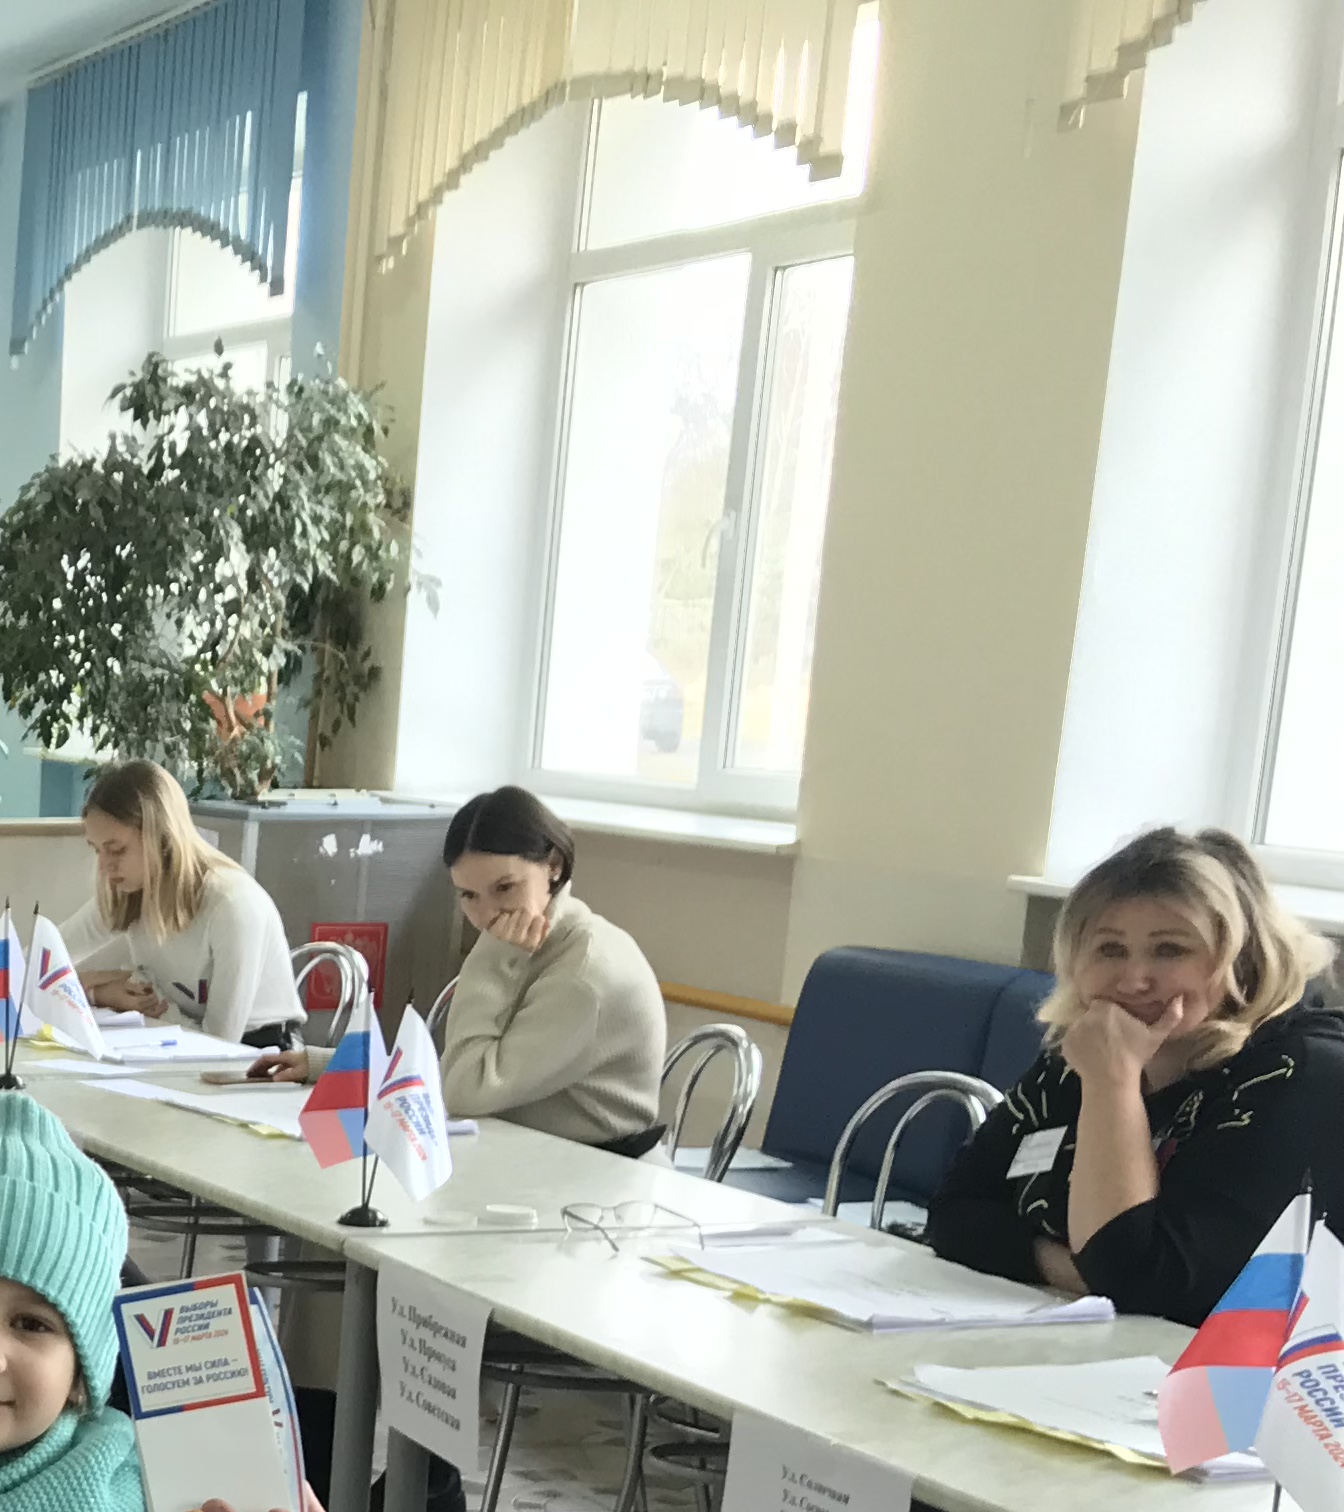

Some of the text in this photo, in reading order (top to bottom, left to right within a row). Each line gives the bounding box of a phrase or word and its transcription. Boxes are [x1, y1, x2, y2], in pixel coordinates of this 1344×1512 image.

[146, 1365, 183, 1380] ВМЕСТЕ
[185, 1362, 202, 1374] МЫ
[204, 1357, 230, 1370] СИЛА
[141, 1377, 190, 1394] ГОЛОСУЕМ
[192, 1375, 205, 1386] ЗА
